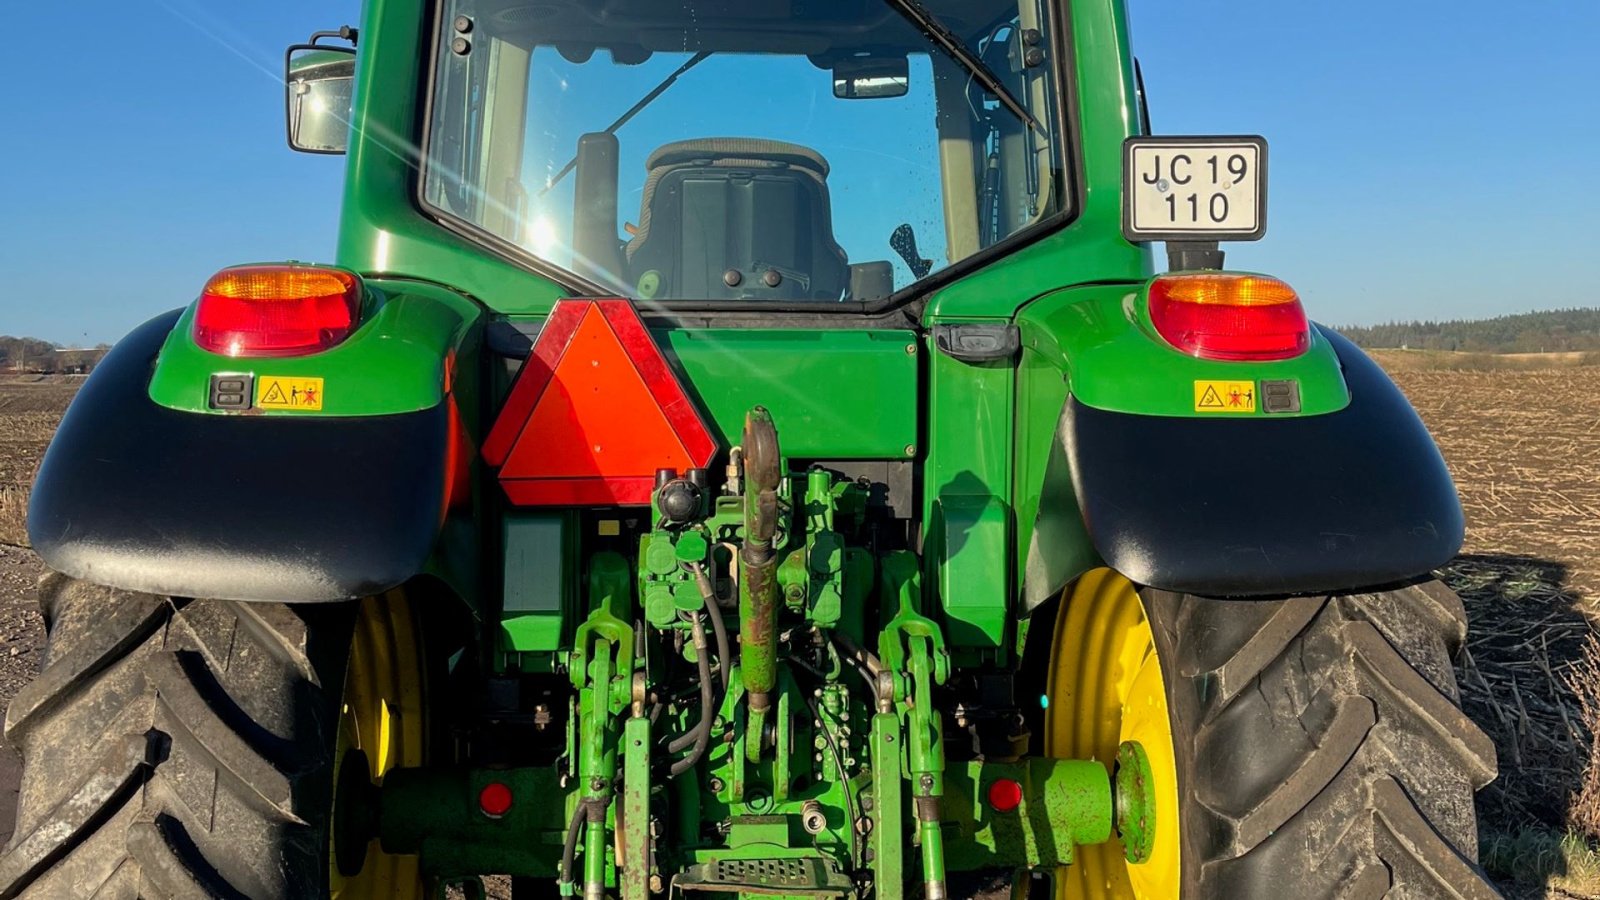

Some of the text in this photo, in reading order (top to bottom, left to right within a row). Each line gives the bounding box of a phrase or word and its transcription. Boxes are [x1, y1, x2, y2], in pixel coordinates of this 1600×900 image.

[1143, 154, 1247, 185] JC 19
[1165, 192, 1229, 223] 110
